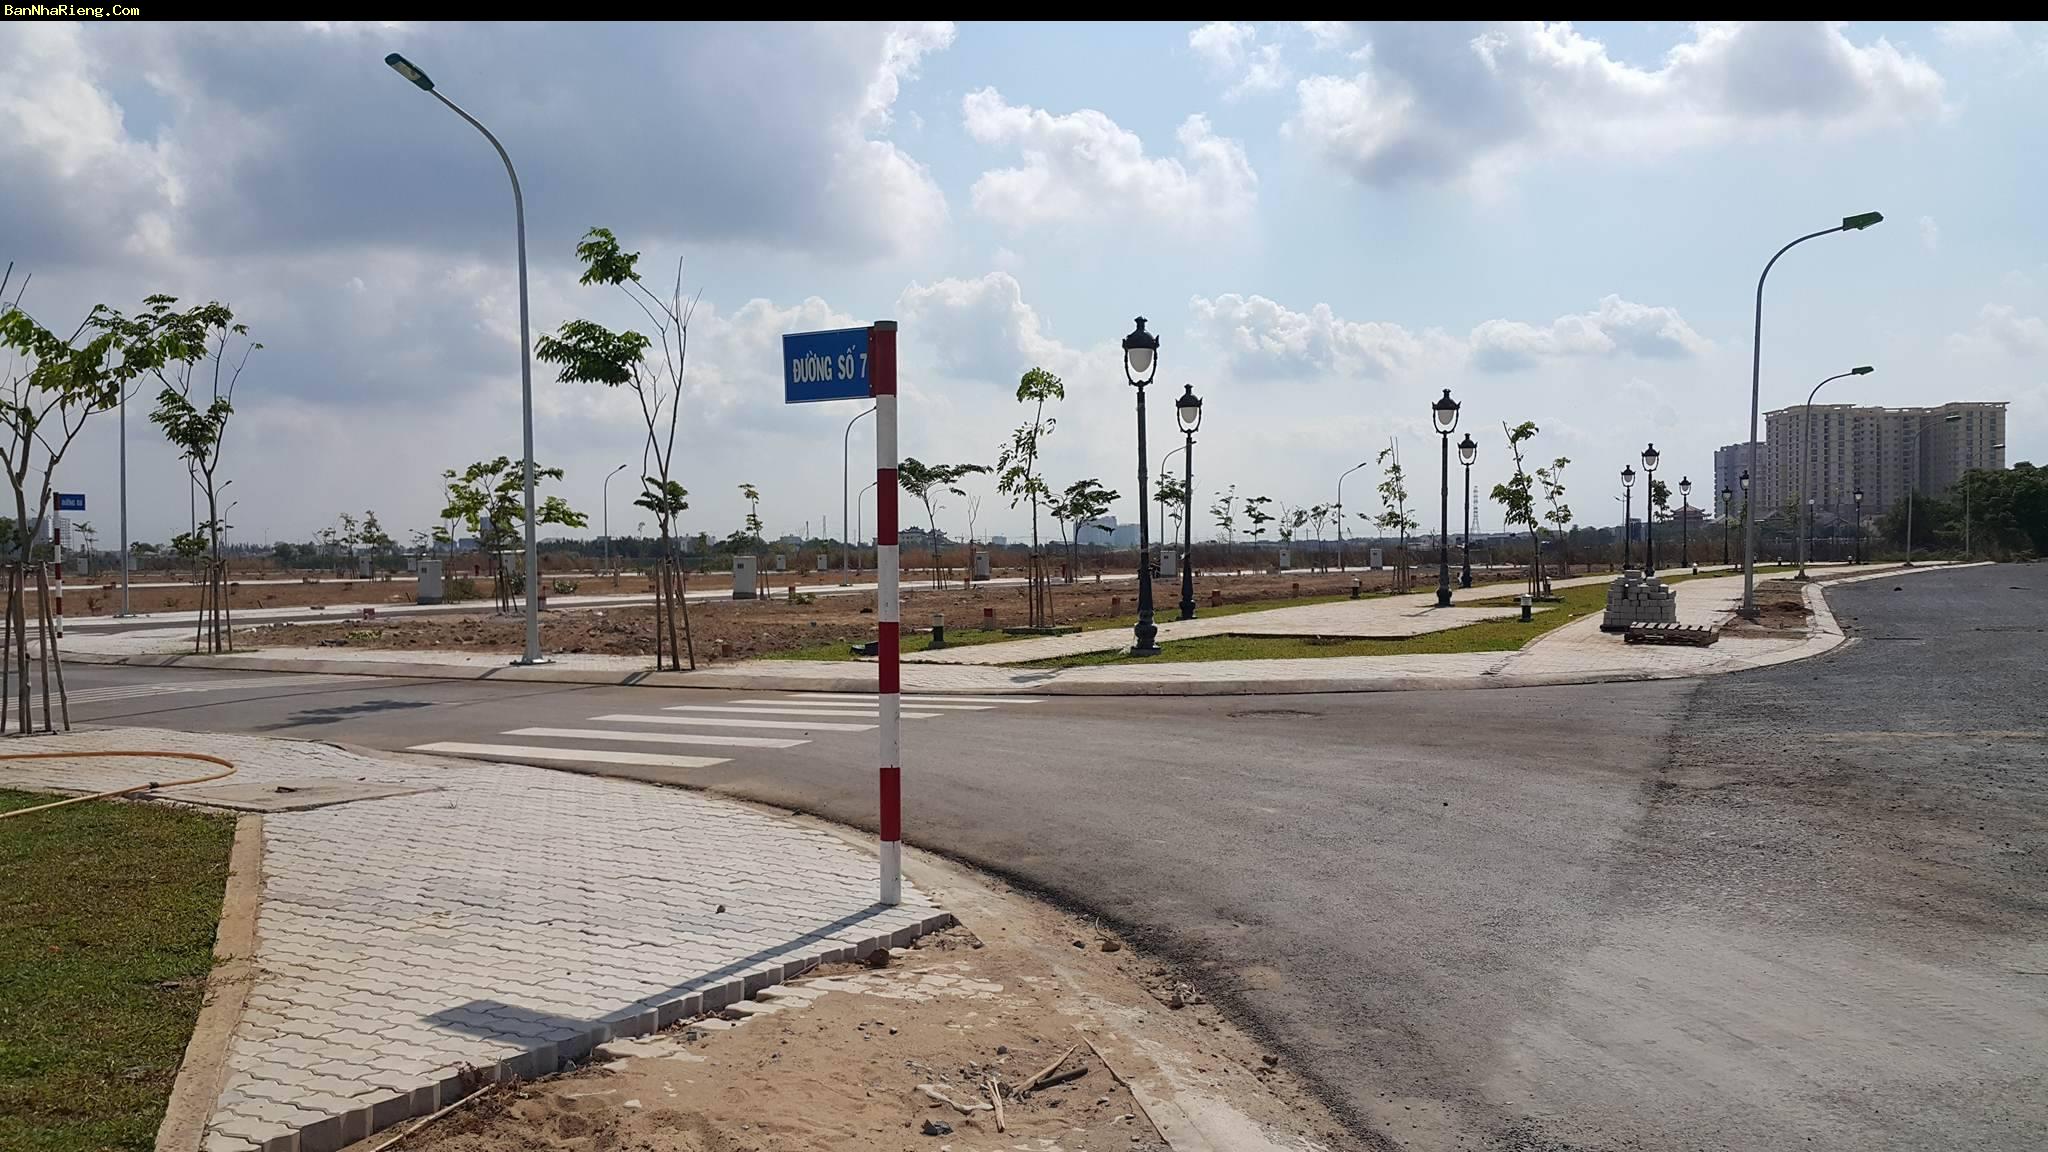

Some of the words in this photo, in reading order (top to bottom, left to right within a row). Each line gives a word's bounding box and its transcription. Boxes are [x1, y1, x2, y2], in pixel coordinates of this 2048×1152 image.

[793, 350, 832, 383] ĐƯỜNG
[837, 344, 856, 380] SỐ
[859, 353, 868, 379] 7
